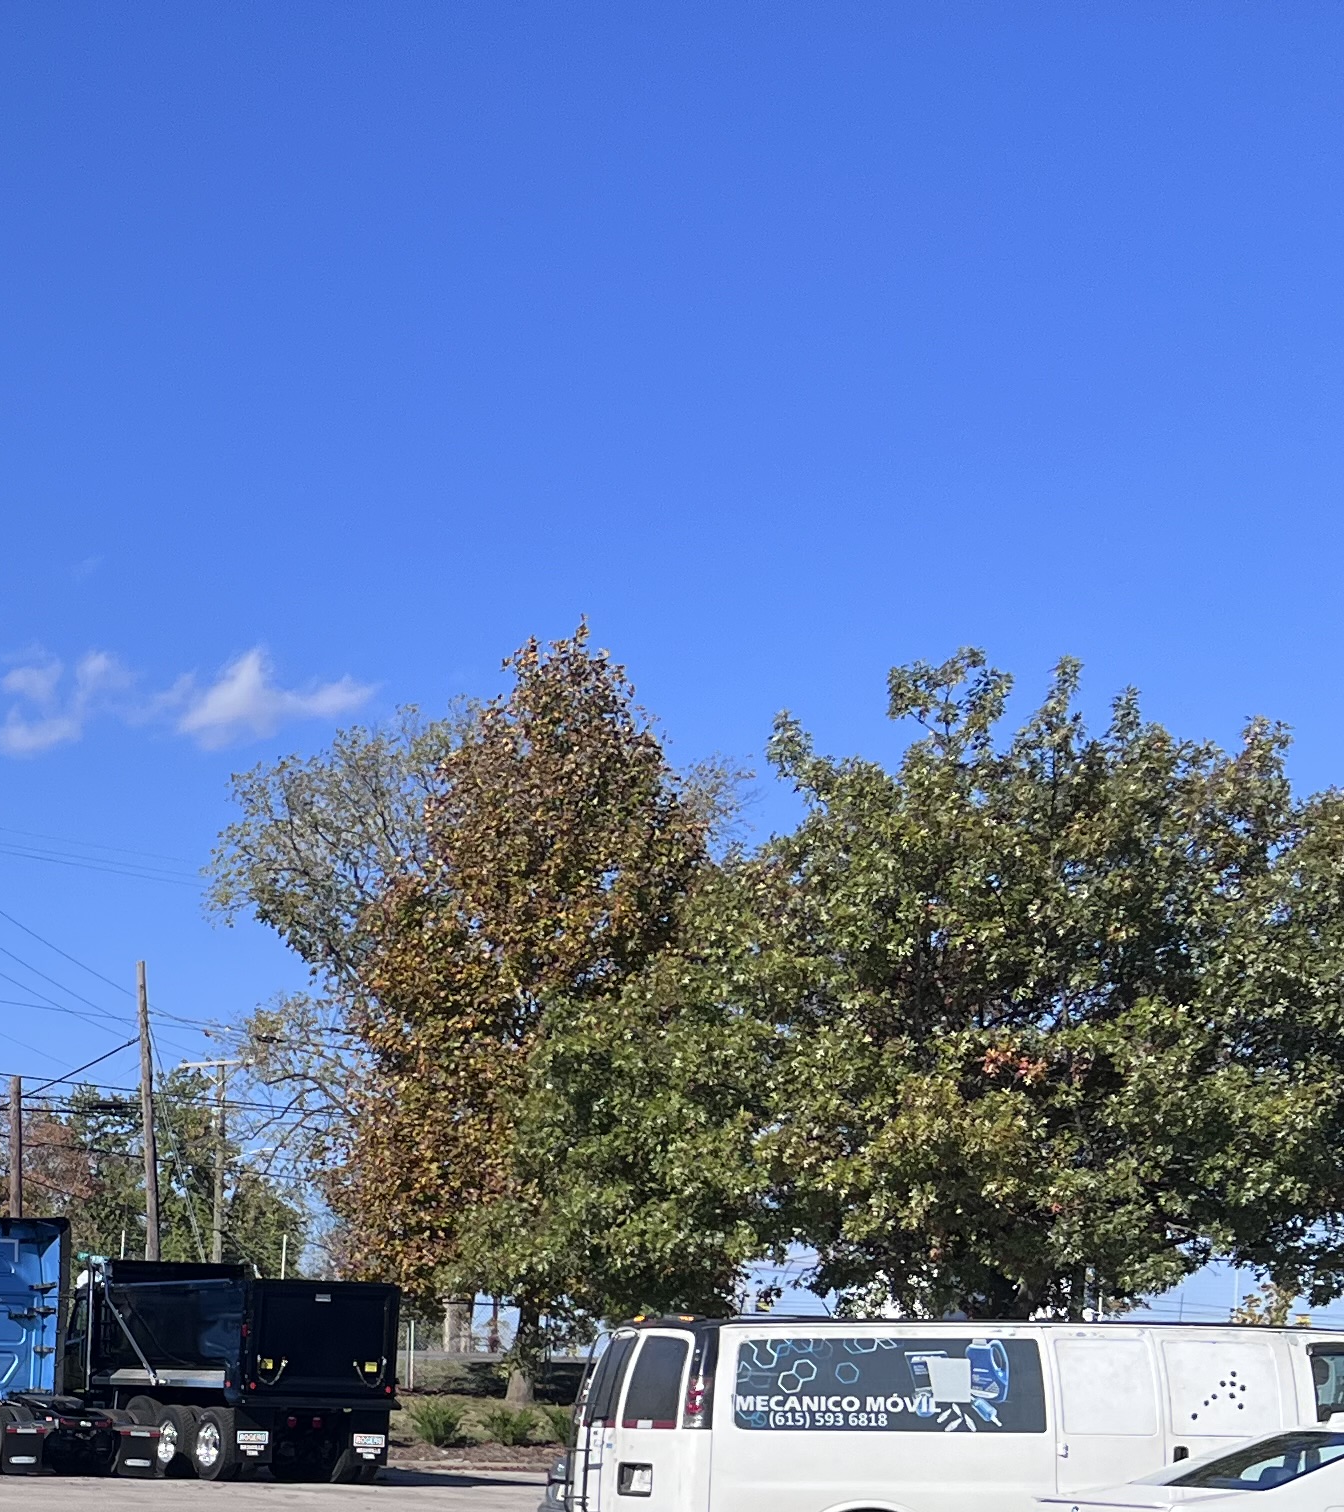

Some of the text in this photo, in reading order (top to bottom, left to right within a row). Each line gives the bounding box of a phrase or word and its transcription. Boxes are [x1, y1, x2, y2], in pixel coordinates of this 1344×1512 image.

[736, 1394, 861, 1412] MECANICO
[769, 1411, 888, 1428] (615) 593 6818
